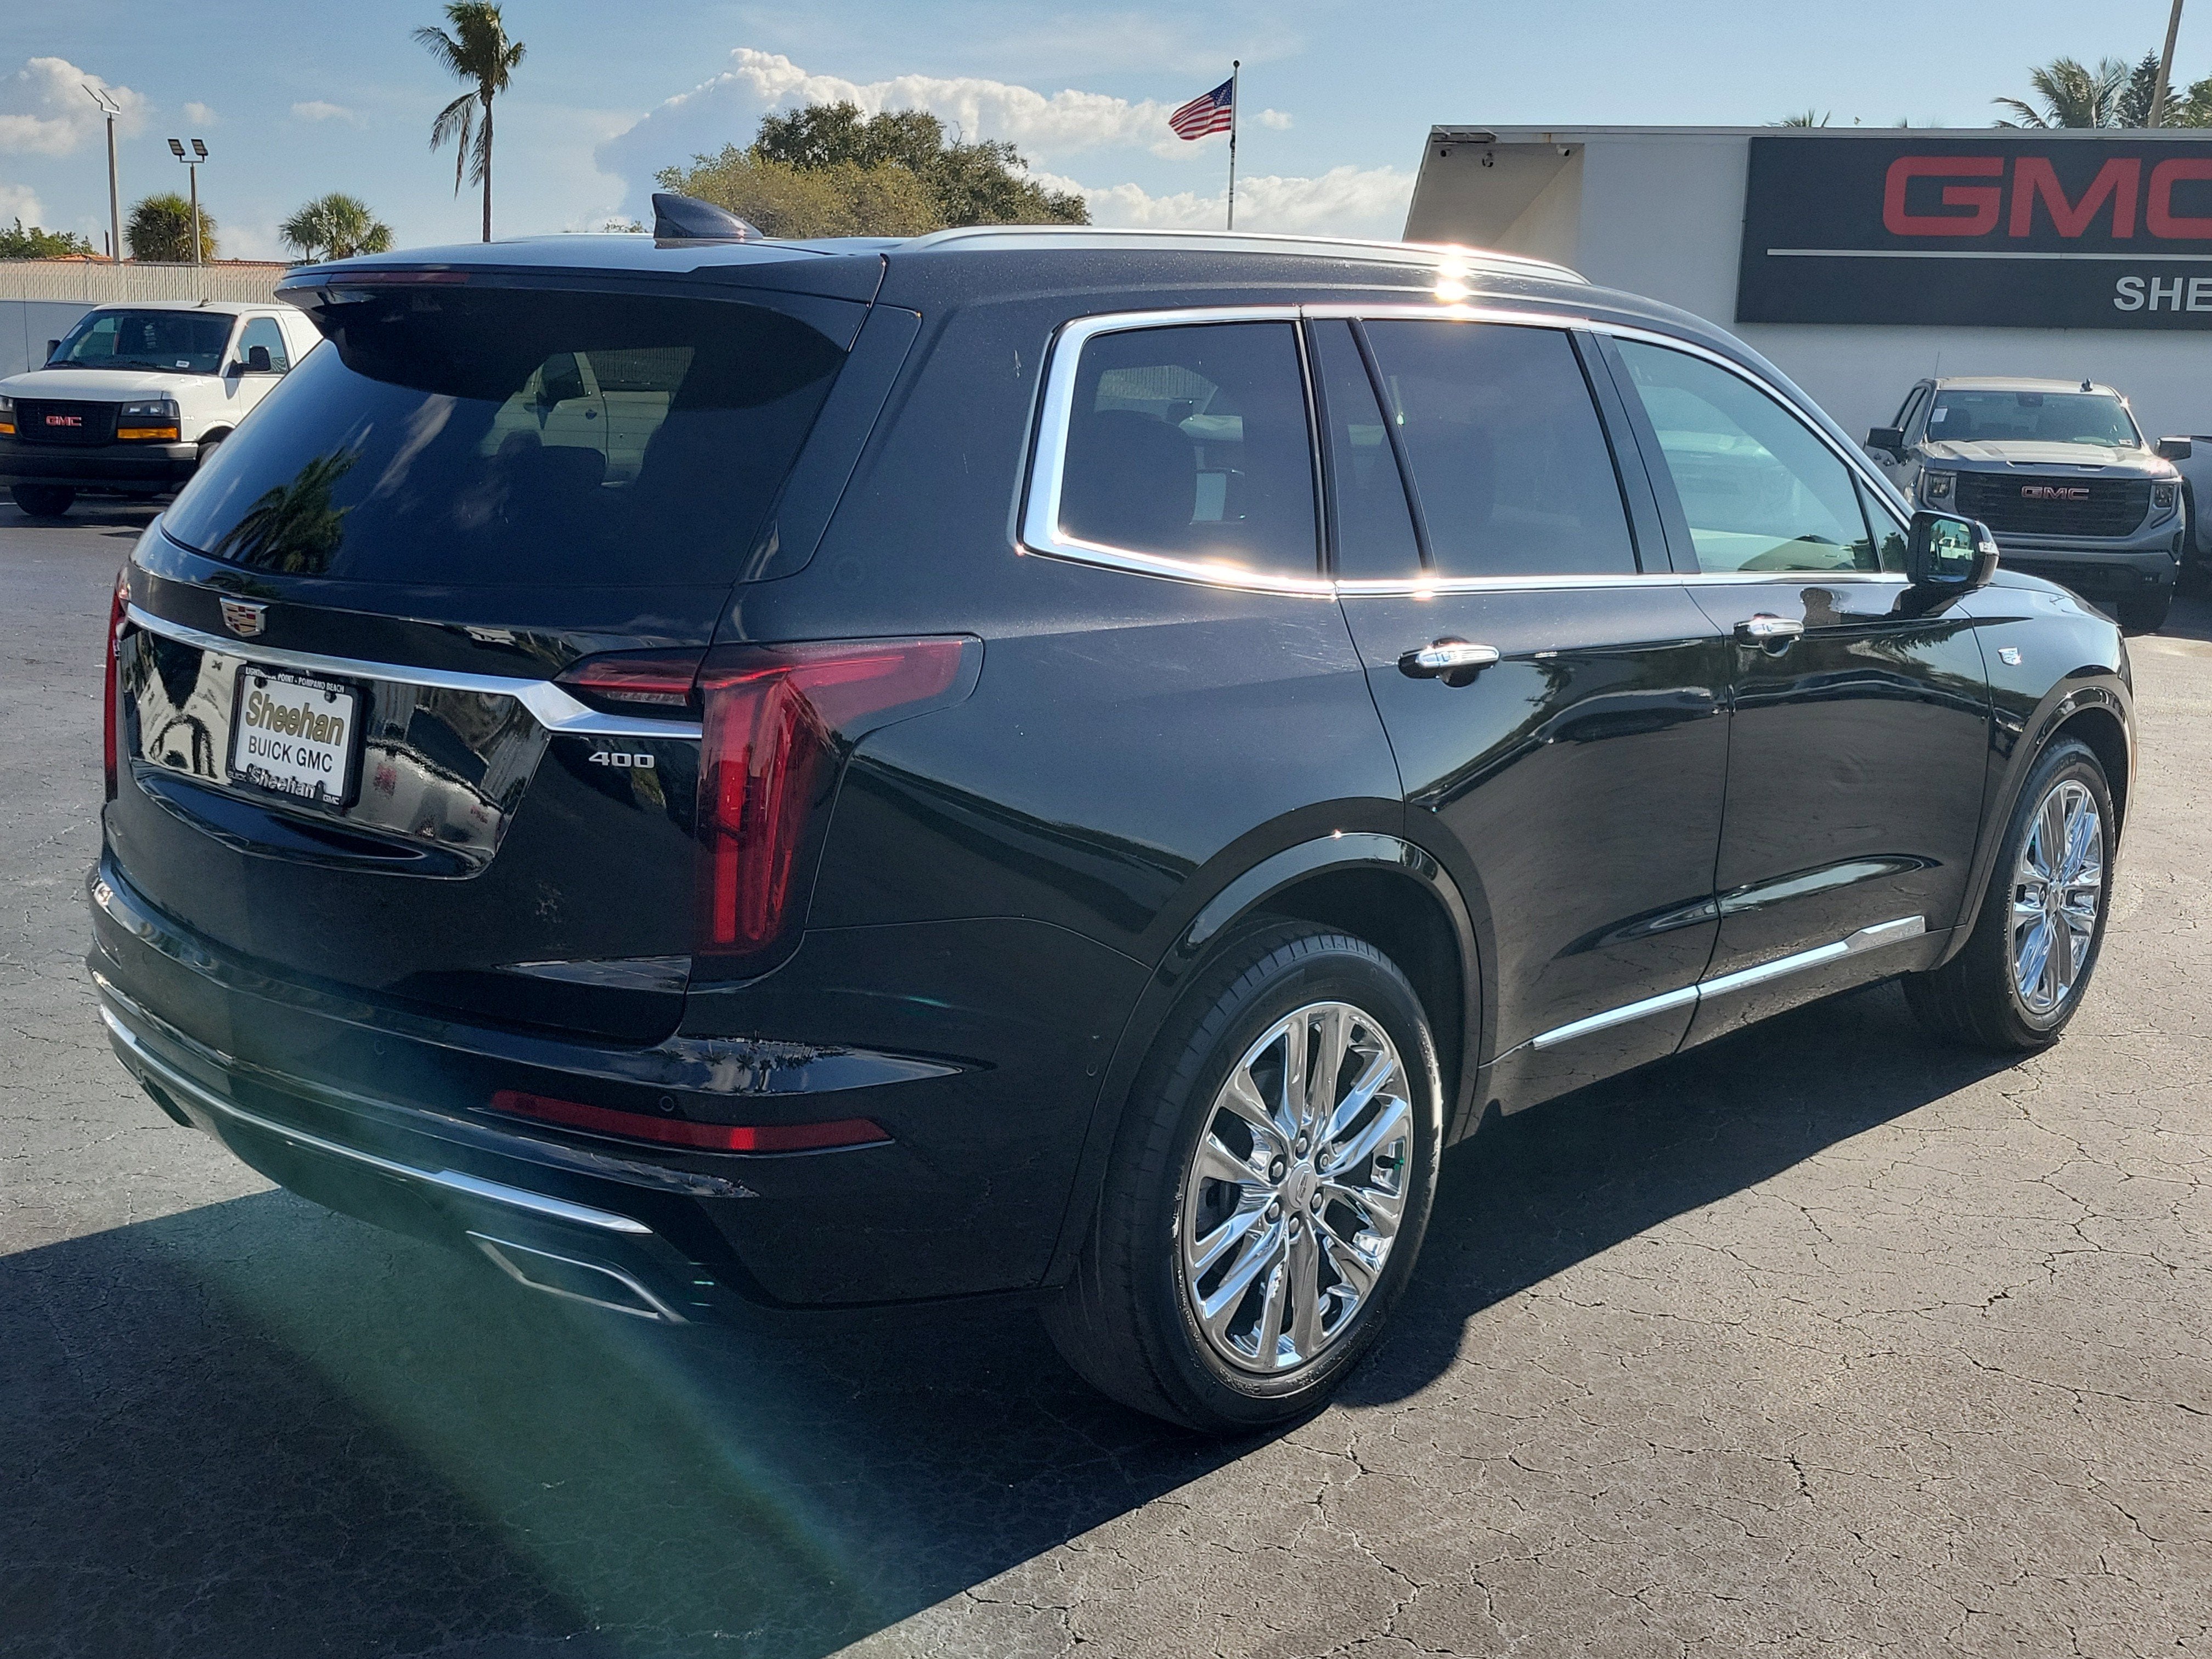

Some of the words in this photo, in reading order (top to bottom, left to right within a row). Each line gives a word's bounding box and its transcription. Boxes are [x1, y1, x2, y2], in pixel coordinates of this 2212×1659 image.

[1882, 156, 2212, 239] GMC
[46, 416, 81, 426] GMC
[2021, 486, 2089, 500] GMC
[326, 682, 345, 693] BEACH
[246, 691, 344, 746] Sheehan
[249, 735, 293, 764] BUICK
[296, 748, 332, 772] GMC
[589, 752, 654, 768] 400
[323, 794, 340, 805] GMC
